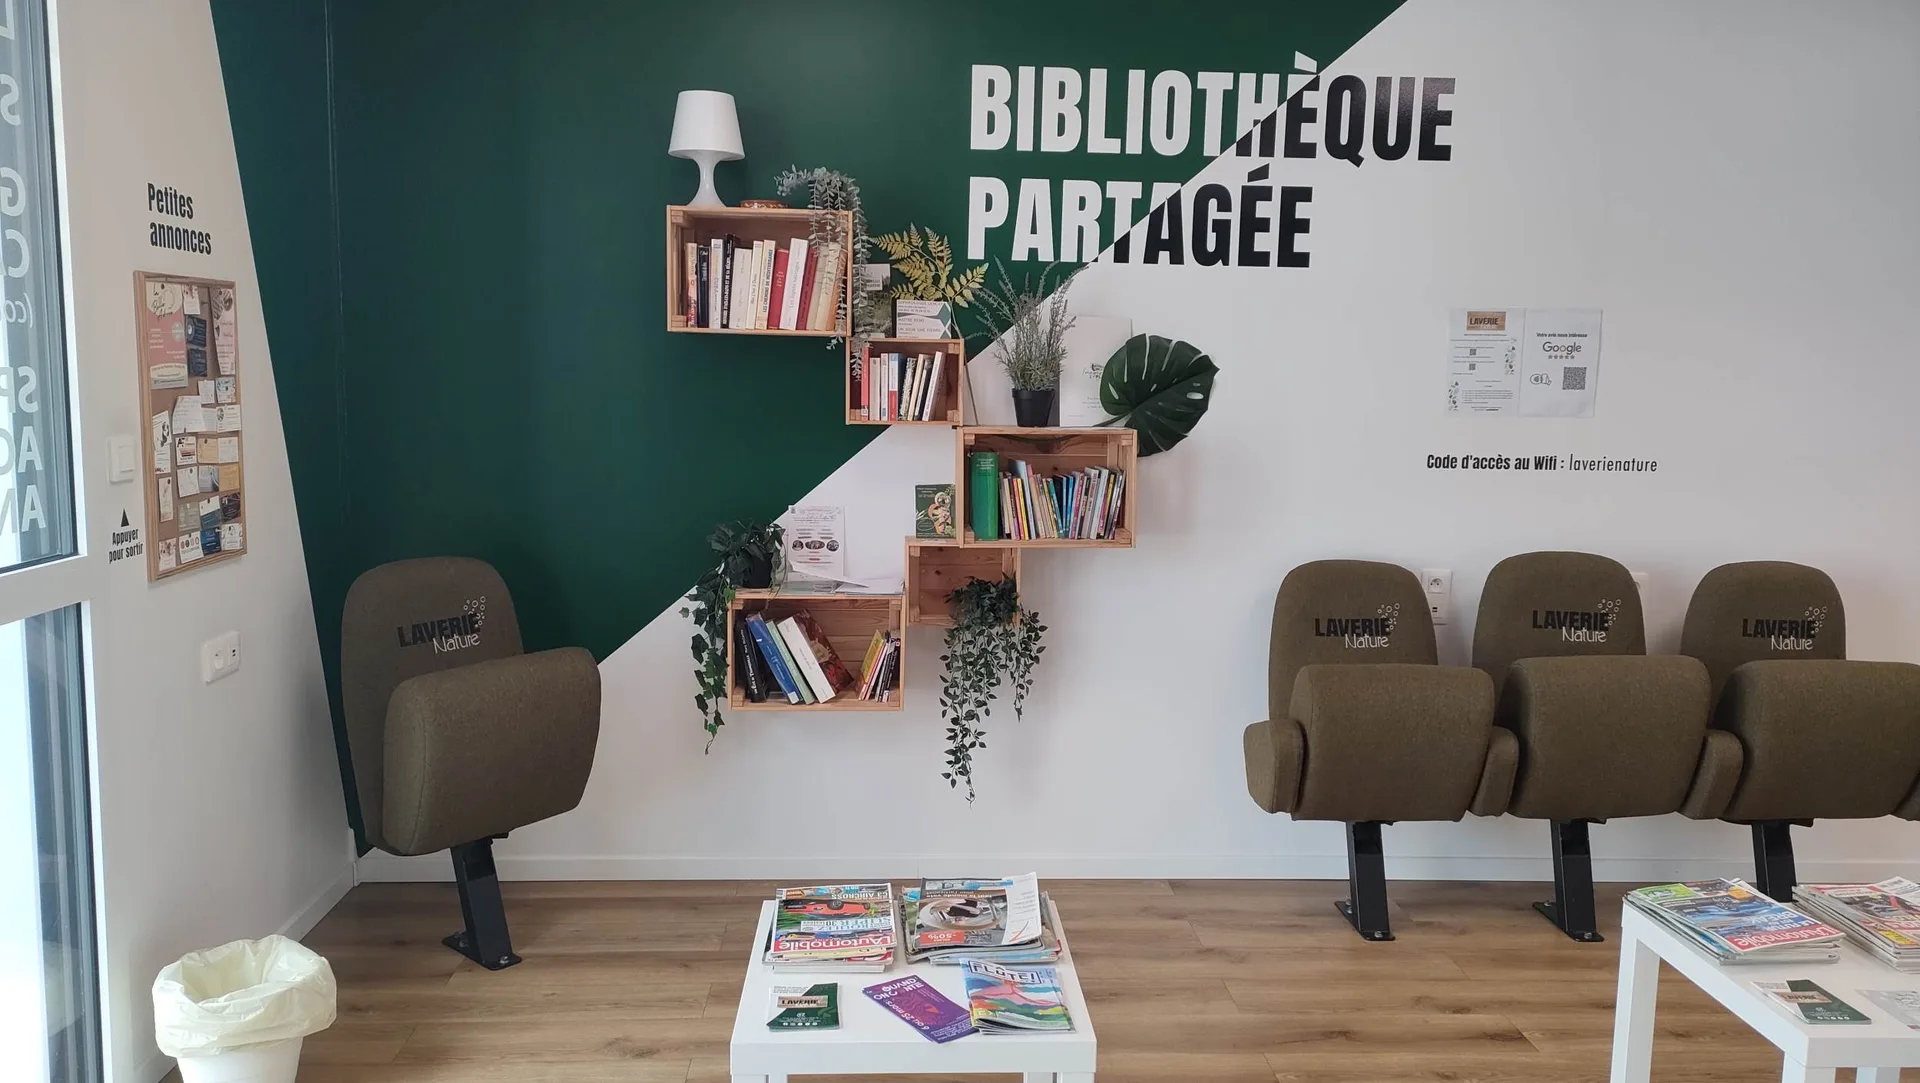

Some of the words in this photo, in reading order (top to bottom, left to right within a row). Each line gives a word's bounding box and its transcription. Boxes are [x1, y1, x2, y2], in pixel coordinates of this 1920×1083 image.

[969, 50, 1457, 168] BIBLIOTHÈQUE
[147, 182, 194, 220] Petites
[966, 162, 1314, 269] PARTAGÉE
[149, 221, 212, 255] annonces
[1469, 317, 1499, 326] LAVERIE
[1542, 341, 1582, 355] Google
[1427, 454, 1458, 469] Code
[1461, 454, 1511, 470] d'accès
[1514, 457, 1530, 470] au
[1534, 455, 1557, 471] Wifi
[1569, 453, 1658, 472] laverienature
[112, 528, 139, 546] Appuyer
[108, 548, 124, 564] pour
[125, 542, 144, 559] sortir
[397, 612, 480, 648] LAVERIE
[1314, 617, 1391, 637] LAVERIE
[1532, 609, 1609, 631] LAVERIE
[1742, 618, 1817, 639] LAVERIE
[432, 633, 481, 654] Nature
[1344, 633, 1390, 649] Nature
[1562, 626, 1607, 643] Nature
[1771, 634, 1814, 651] Nature
[778, 935, 891, 951] L'Automobile
[1734, 926, 1836, 947] L'Automobile
[881, 977, 917, 992] QUAND
